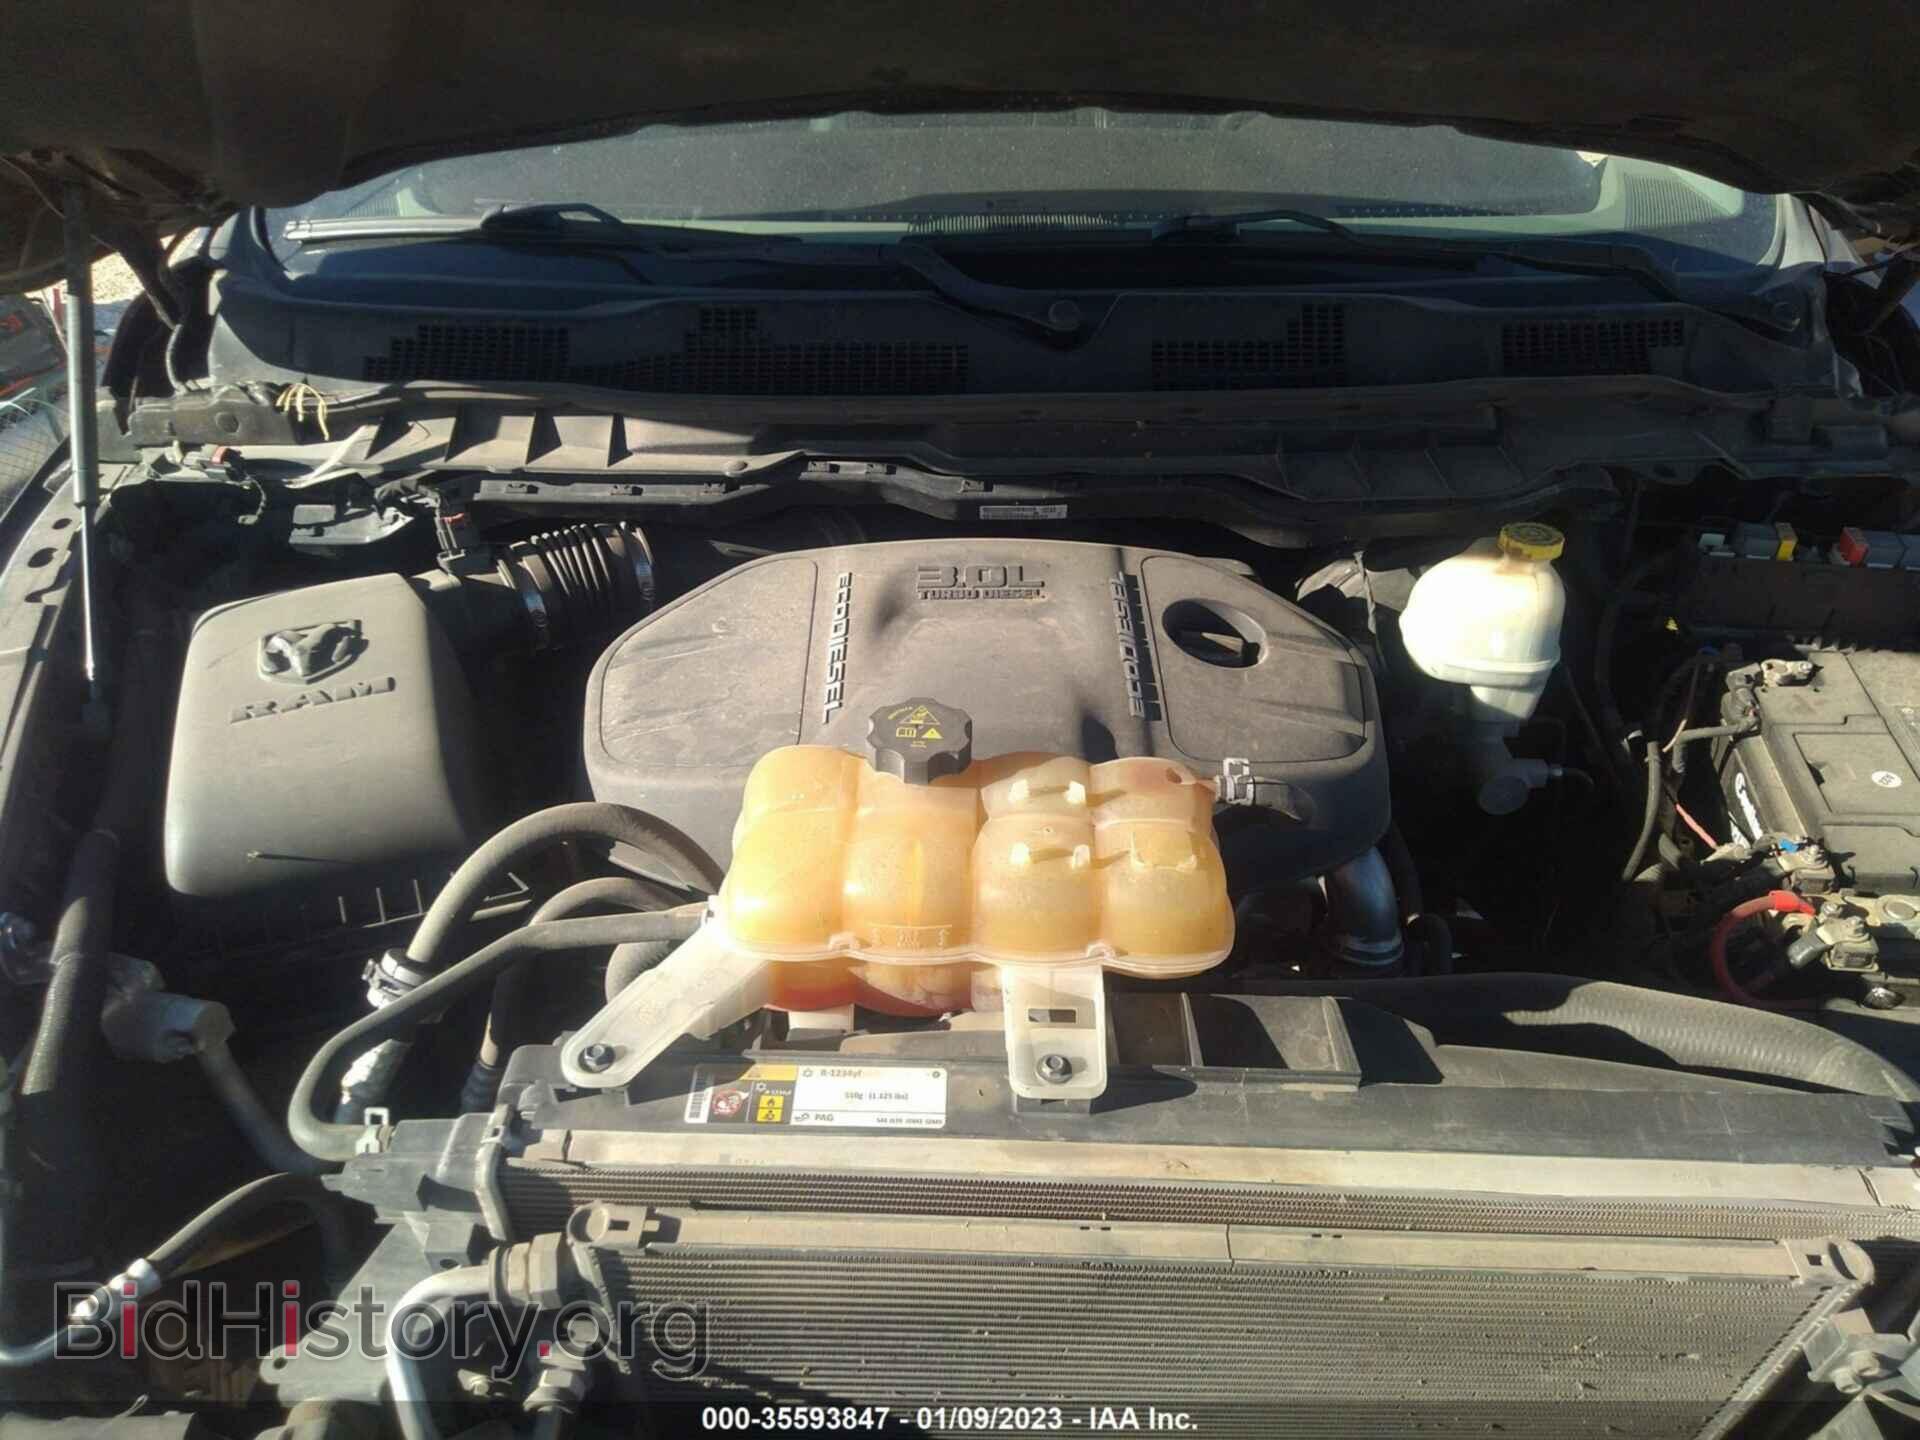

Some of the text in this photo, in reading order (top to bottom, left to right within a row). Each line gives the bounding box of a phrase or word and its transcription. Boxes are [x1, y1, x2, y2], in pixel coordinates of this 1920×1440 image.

[917, 565, 1045, 588] 3.0L
[822, 571, 853, 724] ECODIESEL
[1109, 570, 1146, 718] ECODIESEL
[230, 676, 396, 724] RAM
